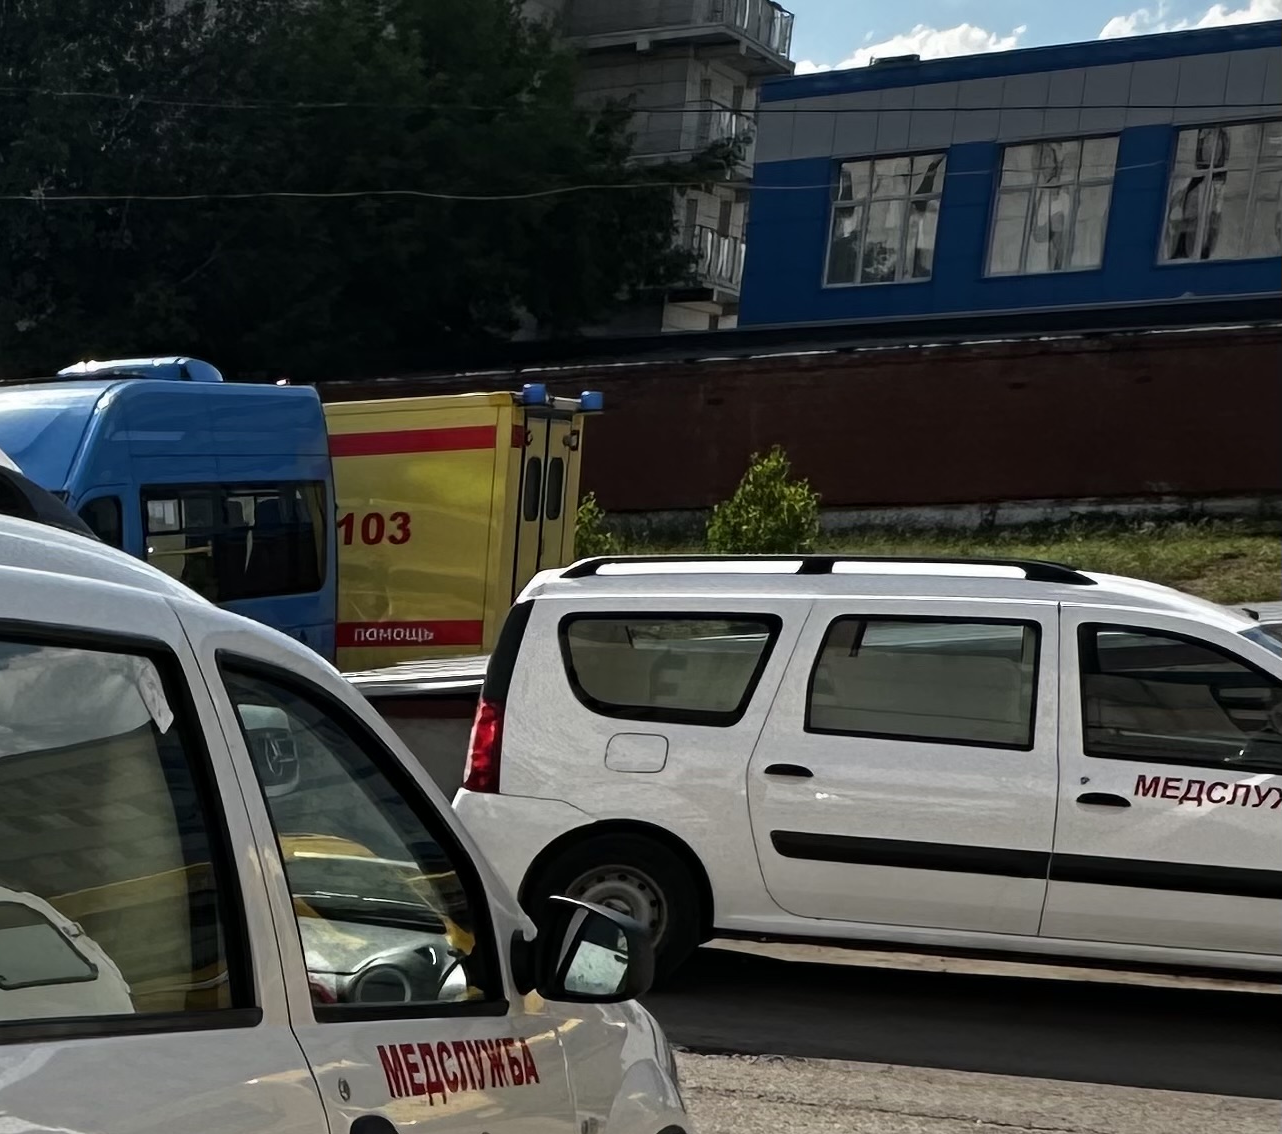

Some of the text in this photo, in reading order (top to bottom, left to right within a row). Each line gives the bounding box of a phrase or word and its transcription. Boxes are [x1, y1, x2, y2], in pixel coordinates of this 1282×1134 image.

[337, 511, 412, 545] 103
[354, 627, 435, 643] ПОМОЩЬ
[376, 1037, 540, 1106] МЕДСЛУЖБА
